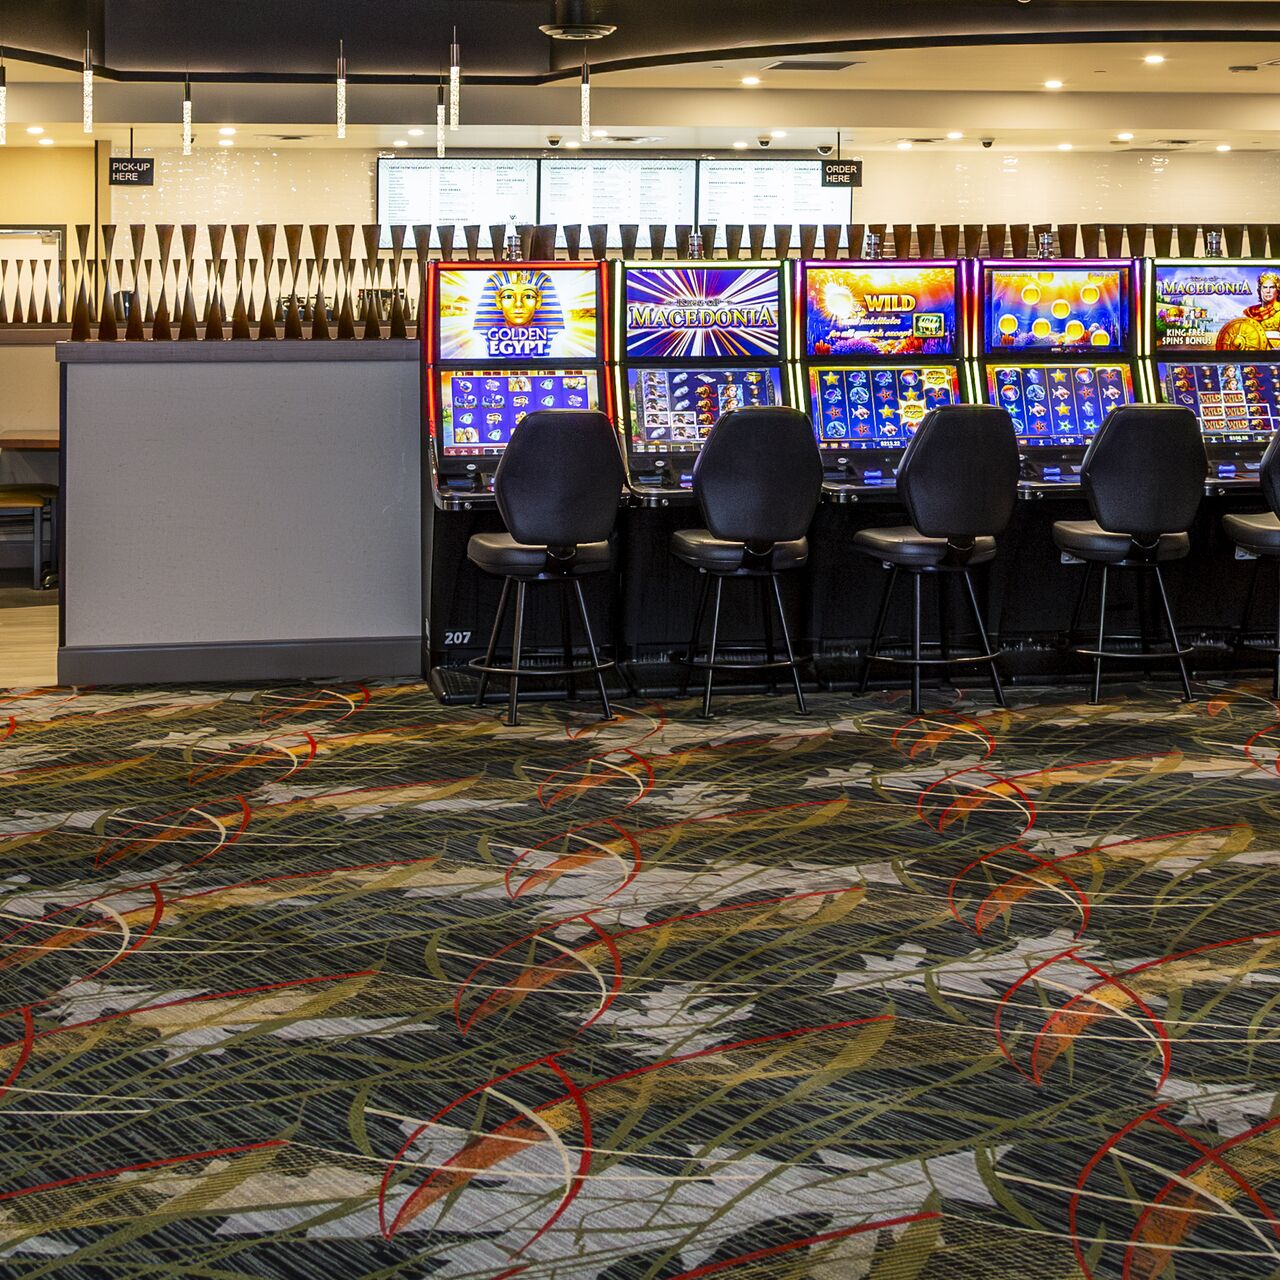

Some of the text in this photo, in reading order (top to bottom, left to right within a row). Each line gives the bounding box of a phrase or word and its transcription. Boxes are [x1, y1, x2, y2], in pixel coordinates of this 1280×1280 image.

[112, 162, 151, 171] PICK-UP
[826, 165, 857, 173] ORDER
[112, 172, 138, 181] HERE
[826, 174, 850, 183] HERE
[1162, 280, 1253, 296] MACEDONIA
[864, 294, 916, 312] WILD
[629, 306, 776, 329] MACEDONIA
[487, 327, 548, 340] GOLDEN
[1166, 328, 1205, 336] KING FREE
[1162, 337, 1212, 345] SPINS BONUS
[489, 340, 547, 355] EGYPT
[1200, 393, 1244, 404] WILD WILD
[1202, 406, 1246, 417] WILD WILD
[1204, 419, 1248, 430] WILD WILD
[444, 631, 472, 645] 207
